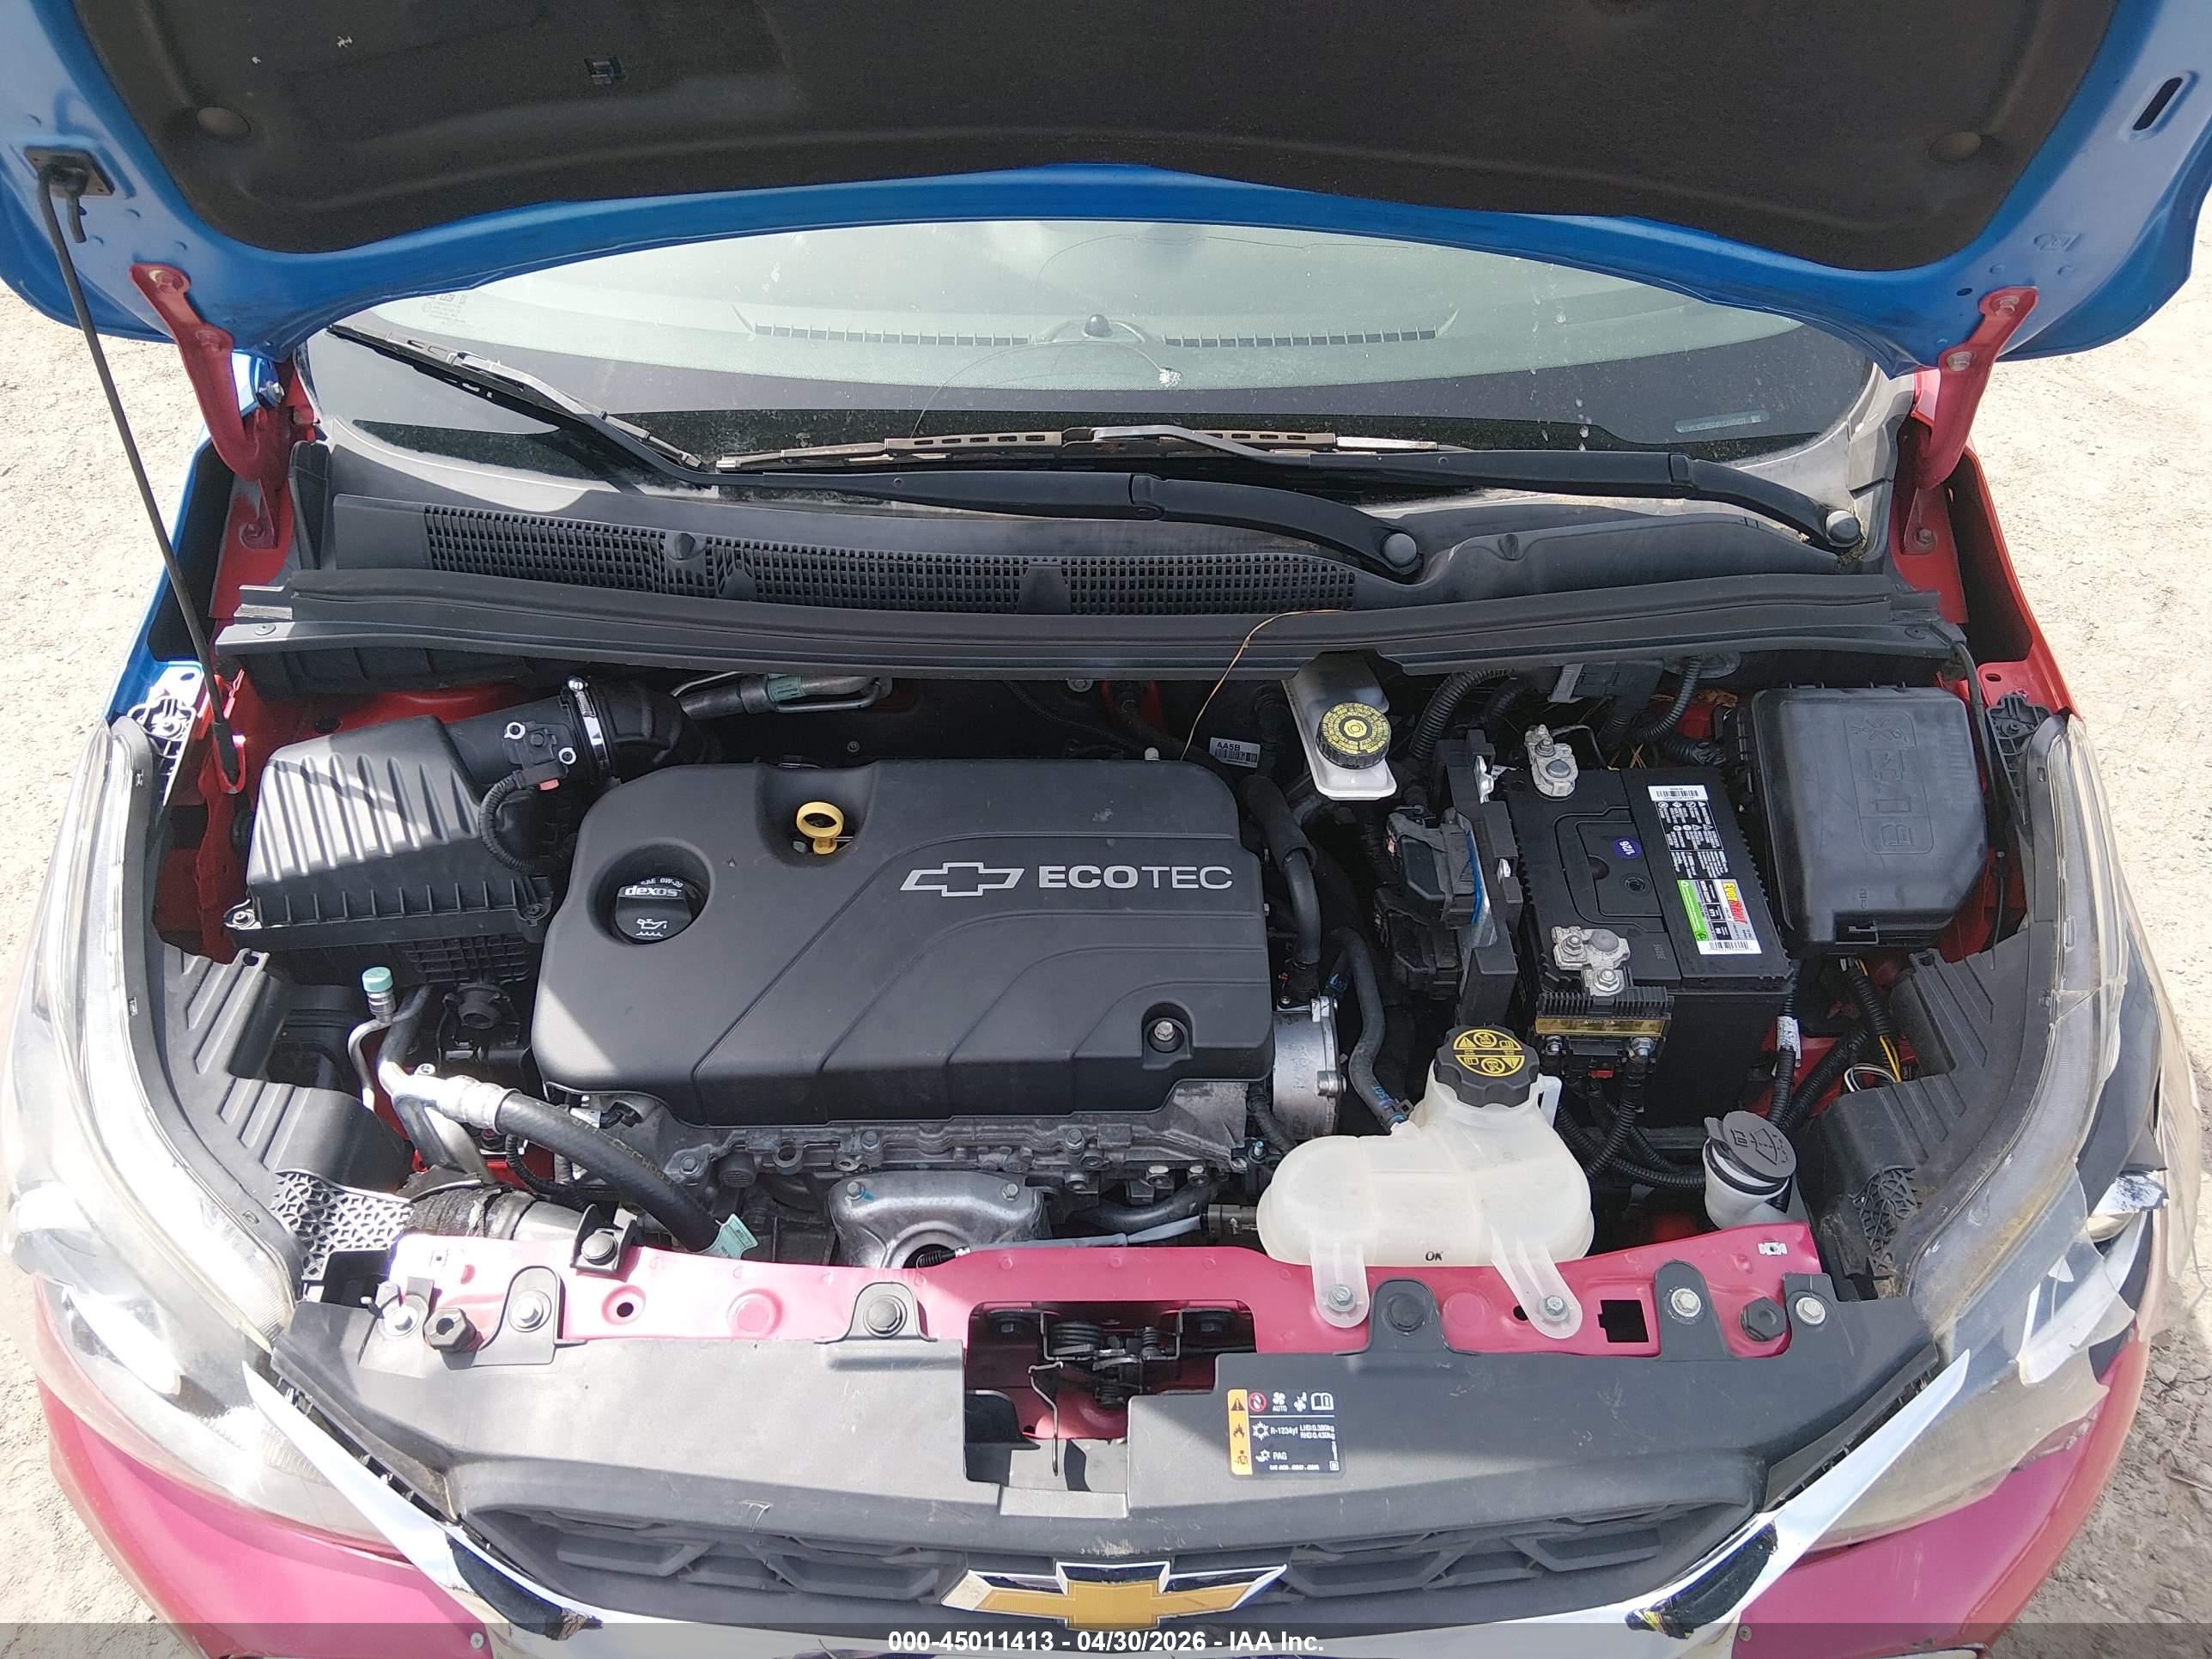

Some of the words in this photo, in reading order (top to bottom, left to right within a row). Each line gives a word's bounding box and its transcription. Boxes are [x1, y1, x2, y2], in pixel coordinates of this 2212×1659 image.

[1216, 741, 1241, 751] AA5B
[1619, 841, 1636, 855] 1/26
[1038, 865, 1233, 890] ECOTEC
[624, 885, 682, 896] dexos
[1425, 1250, 1443, 1261] OK
[1270, 1426, 1298, 1437] R-1234yf
[1273, 1451, 1288, 1461] PAG
